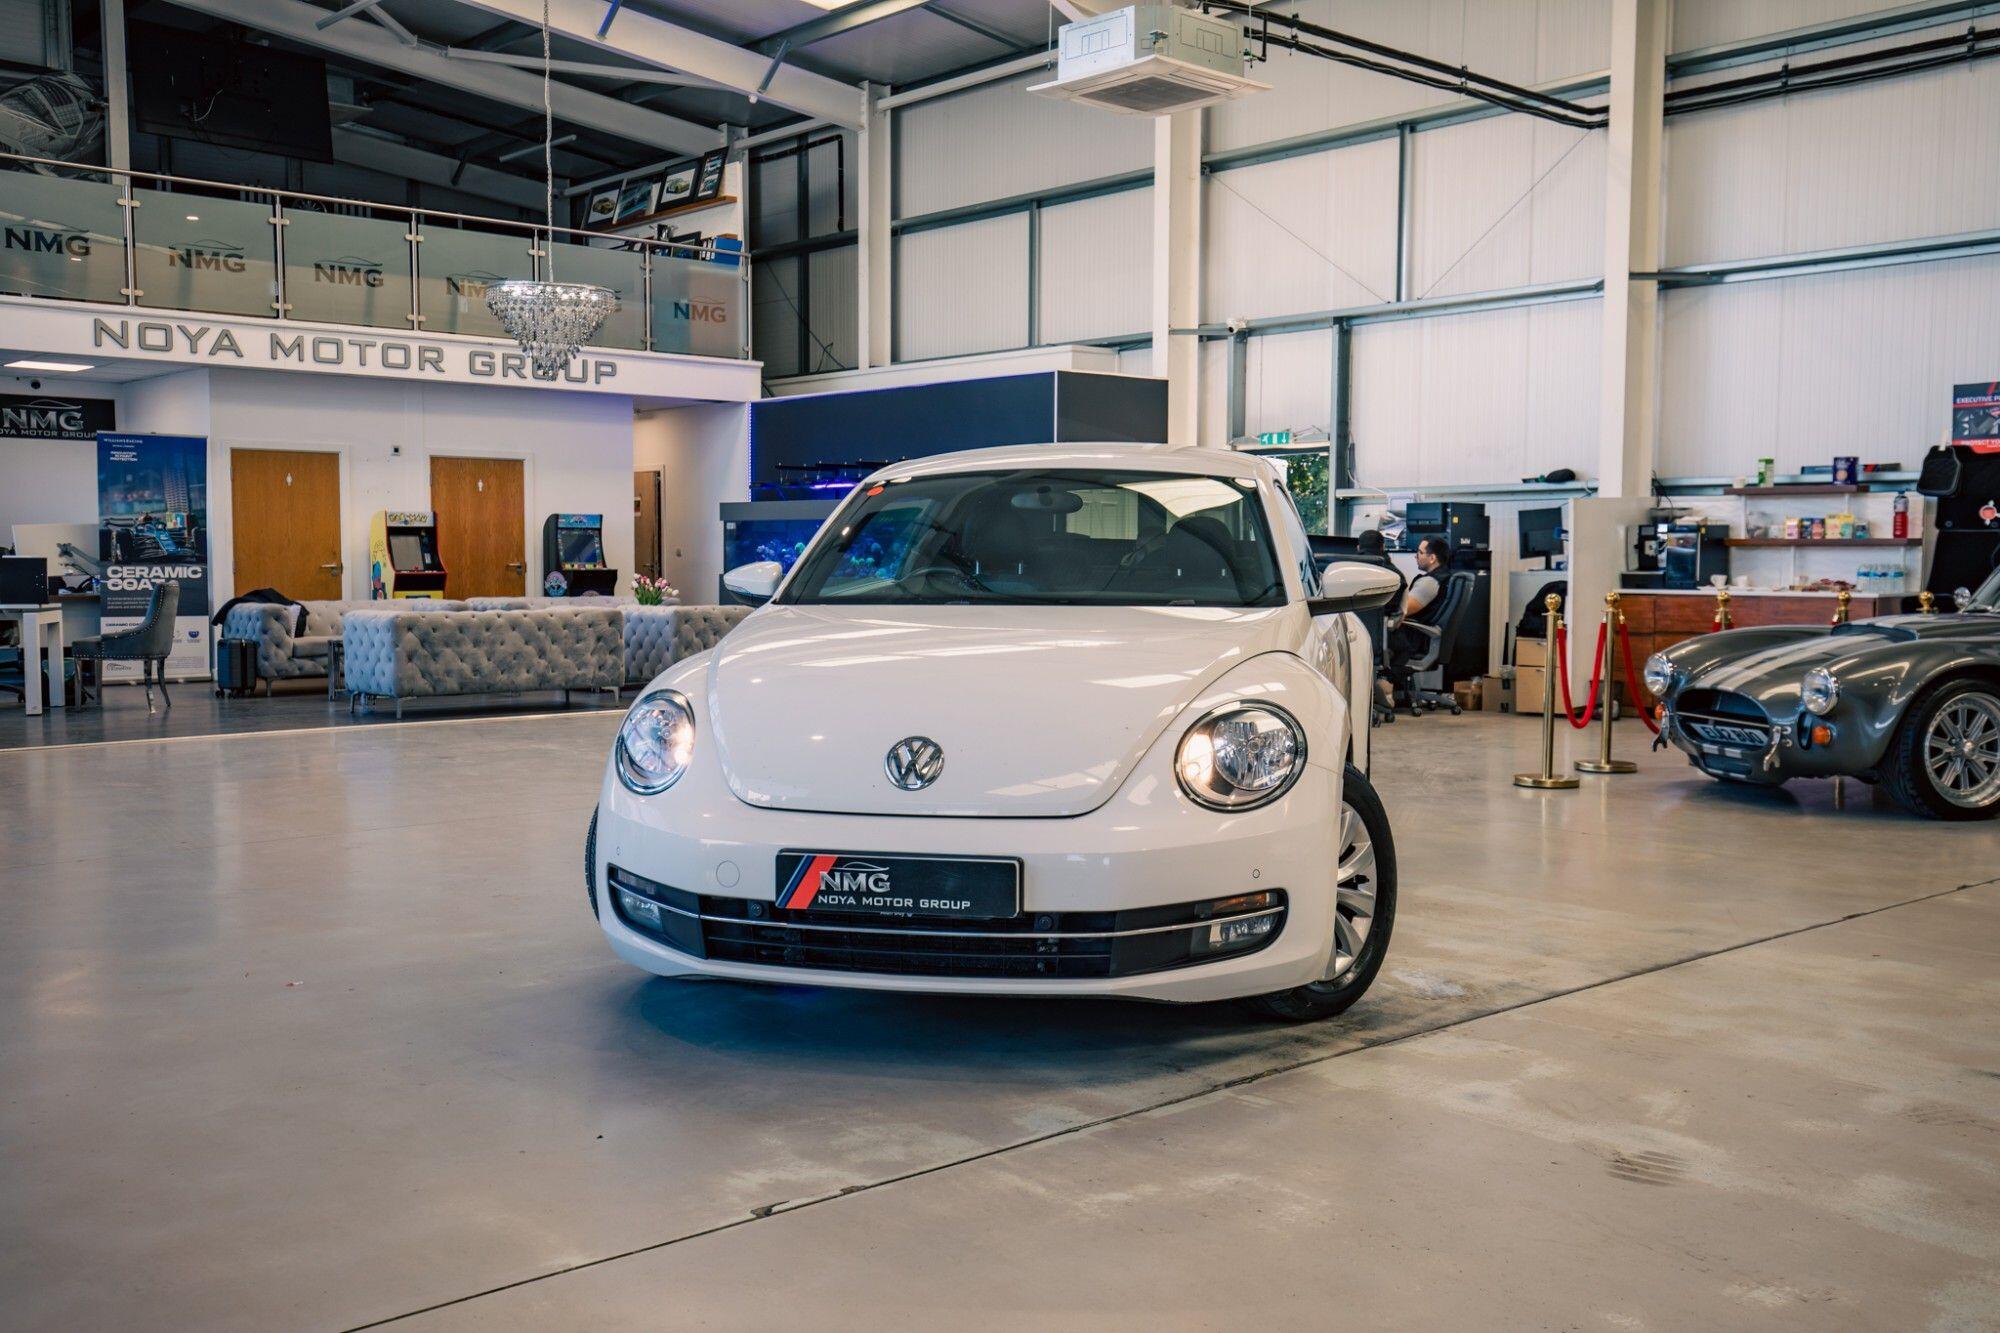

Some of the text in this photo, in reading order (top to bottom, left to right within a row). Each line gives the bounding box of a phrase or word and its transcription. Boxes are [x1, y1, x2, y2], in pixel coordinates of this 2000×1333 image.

[5, 227, 91, 257] NMG
[169, 247, 246, 273] NMG
[314, 263, 384, 288] NMG
[446, 277, 487, 298] NM
[674, 302, 727, 323] NMG
[94, 318, 244, 358] NOYA
[271, 332, 445, 373] MOTOR
[1957, 395, 1992, 403] EXECUTIVE
[2, 408, 84, 431] NMG
[107, 565, 202, 578] CERAMIC
[819, 871, 890, 893] NMG
[818, 895, 971, 910] NOYA MOTOR GROUP
